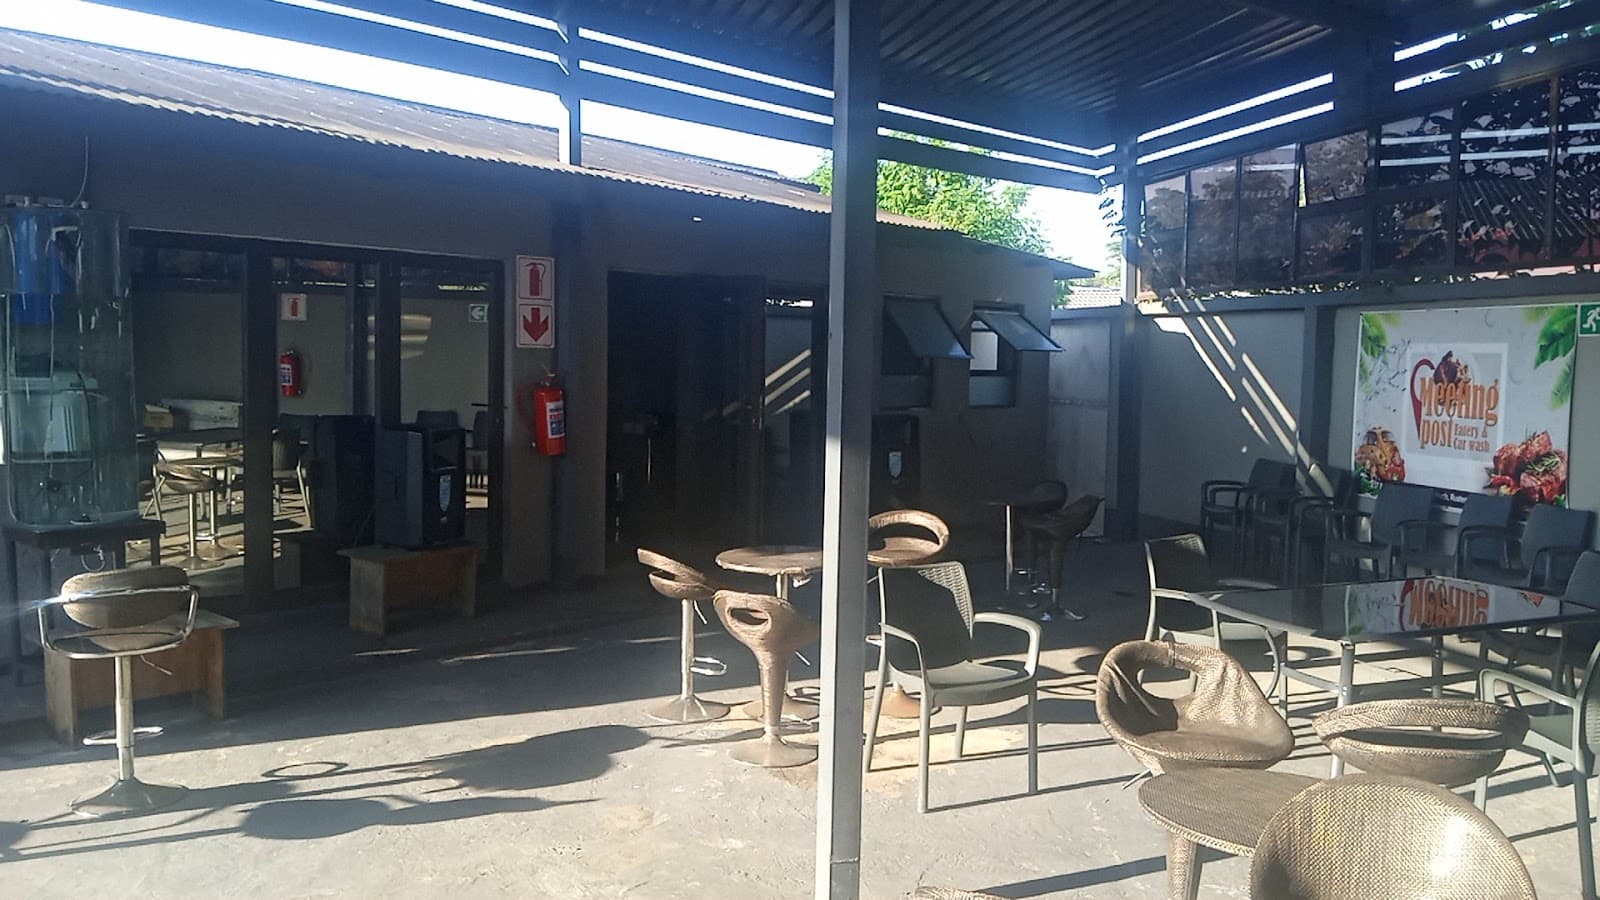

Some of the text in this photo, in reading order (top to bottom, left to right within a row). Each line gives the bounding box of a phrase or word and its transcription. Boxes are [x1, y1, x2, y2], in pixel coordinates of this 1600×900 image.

[1420, 378, 1499, 426] Meeting
[1421, 418, 1453, 449] post
[1454, 423, 1478, 439] Eatery
[1469, 439, 1489, 452] wash
